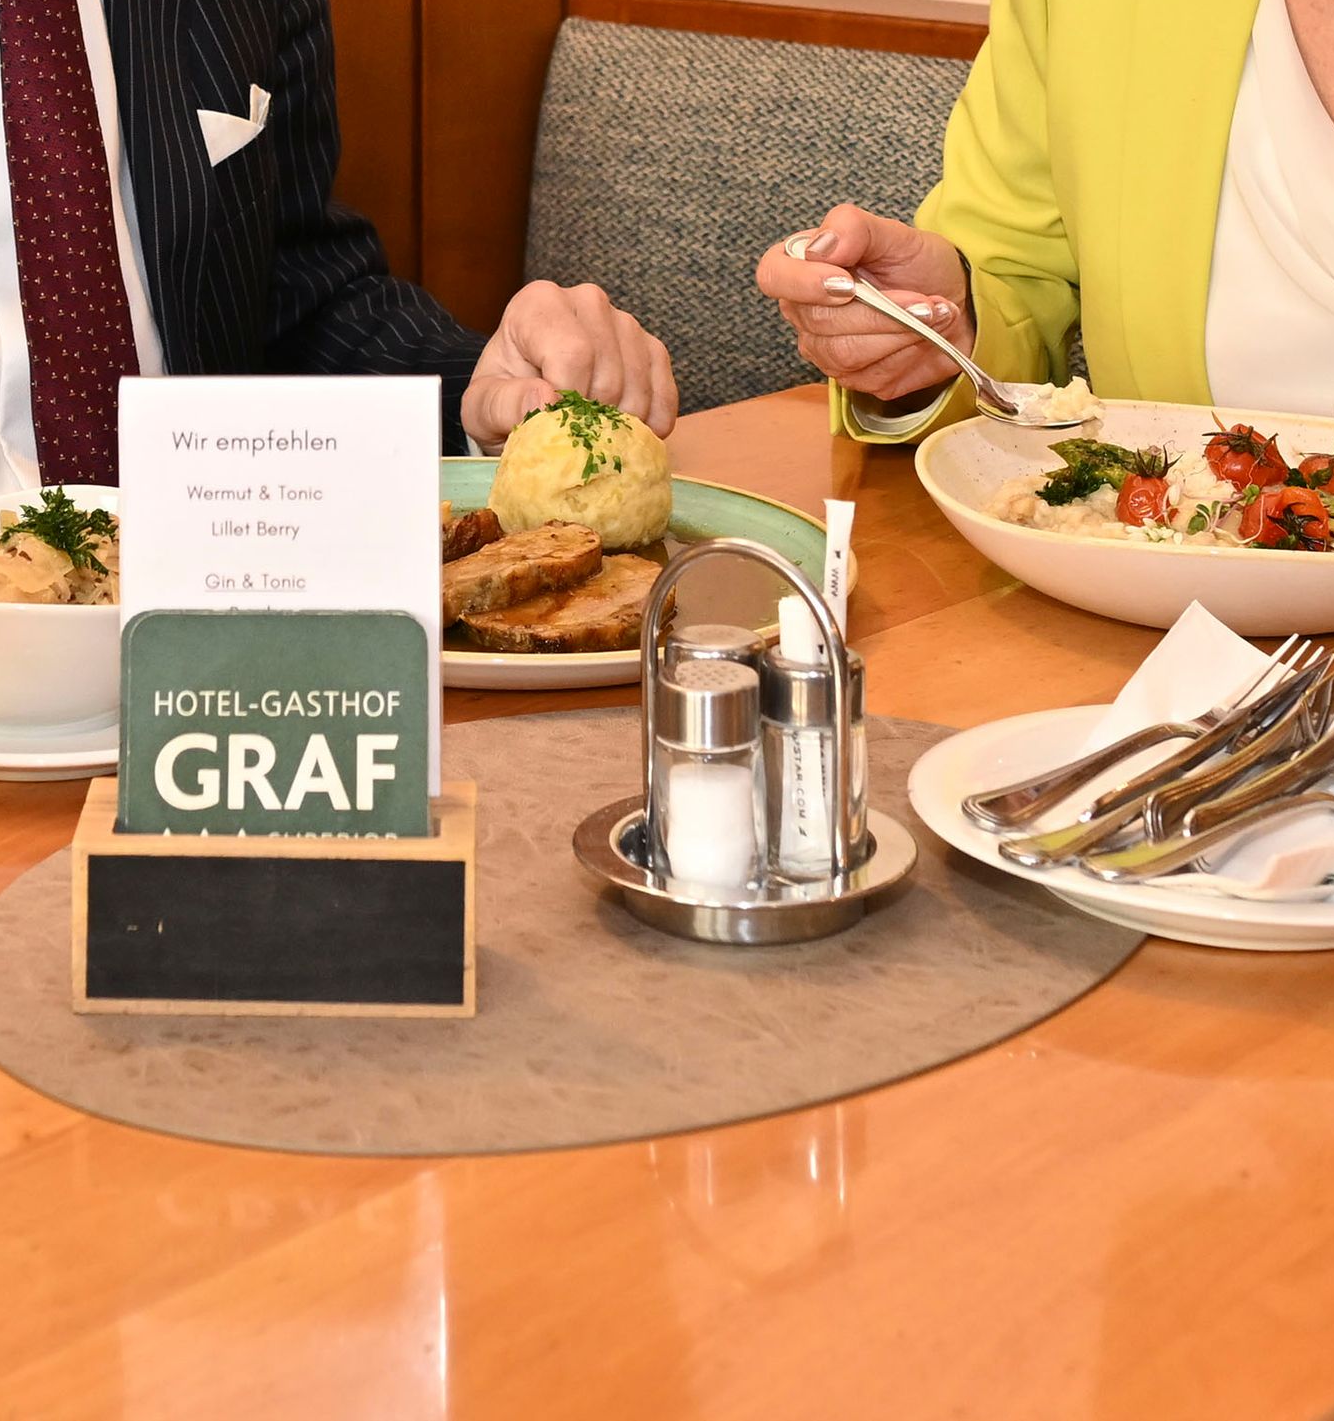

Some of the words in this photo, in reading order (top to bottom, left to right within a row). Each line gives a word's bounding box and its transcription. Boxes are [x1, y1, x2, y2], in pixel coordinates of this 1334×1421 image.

[172, 431, 208, 451] Wir
[216, 429, 337, 457] empfehlen
[187, 485, 252, 501] Wermut
[259, 485, 270, 501] &
[278, 485, 323, 501] Tonic
[212, 521, 250, 537] Lillet
[257, 521, 300, 540] Berry
[205, 573, 235, 590] Gin
[242, 573, 253, 590] &
[263, 573, 306, 590] Tonic
[153, 690, 401, 718] HOTEL-GASTHOF
[153, 732, 400, 812] GRAF
